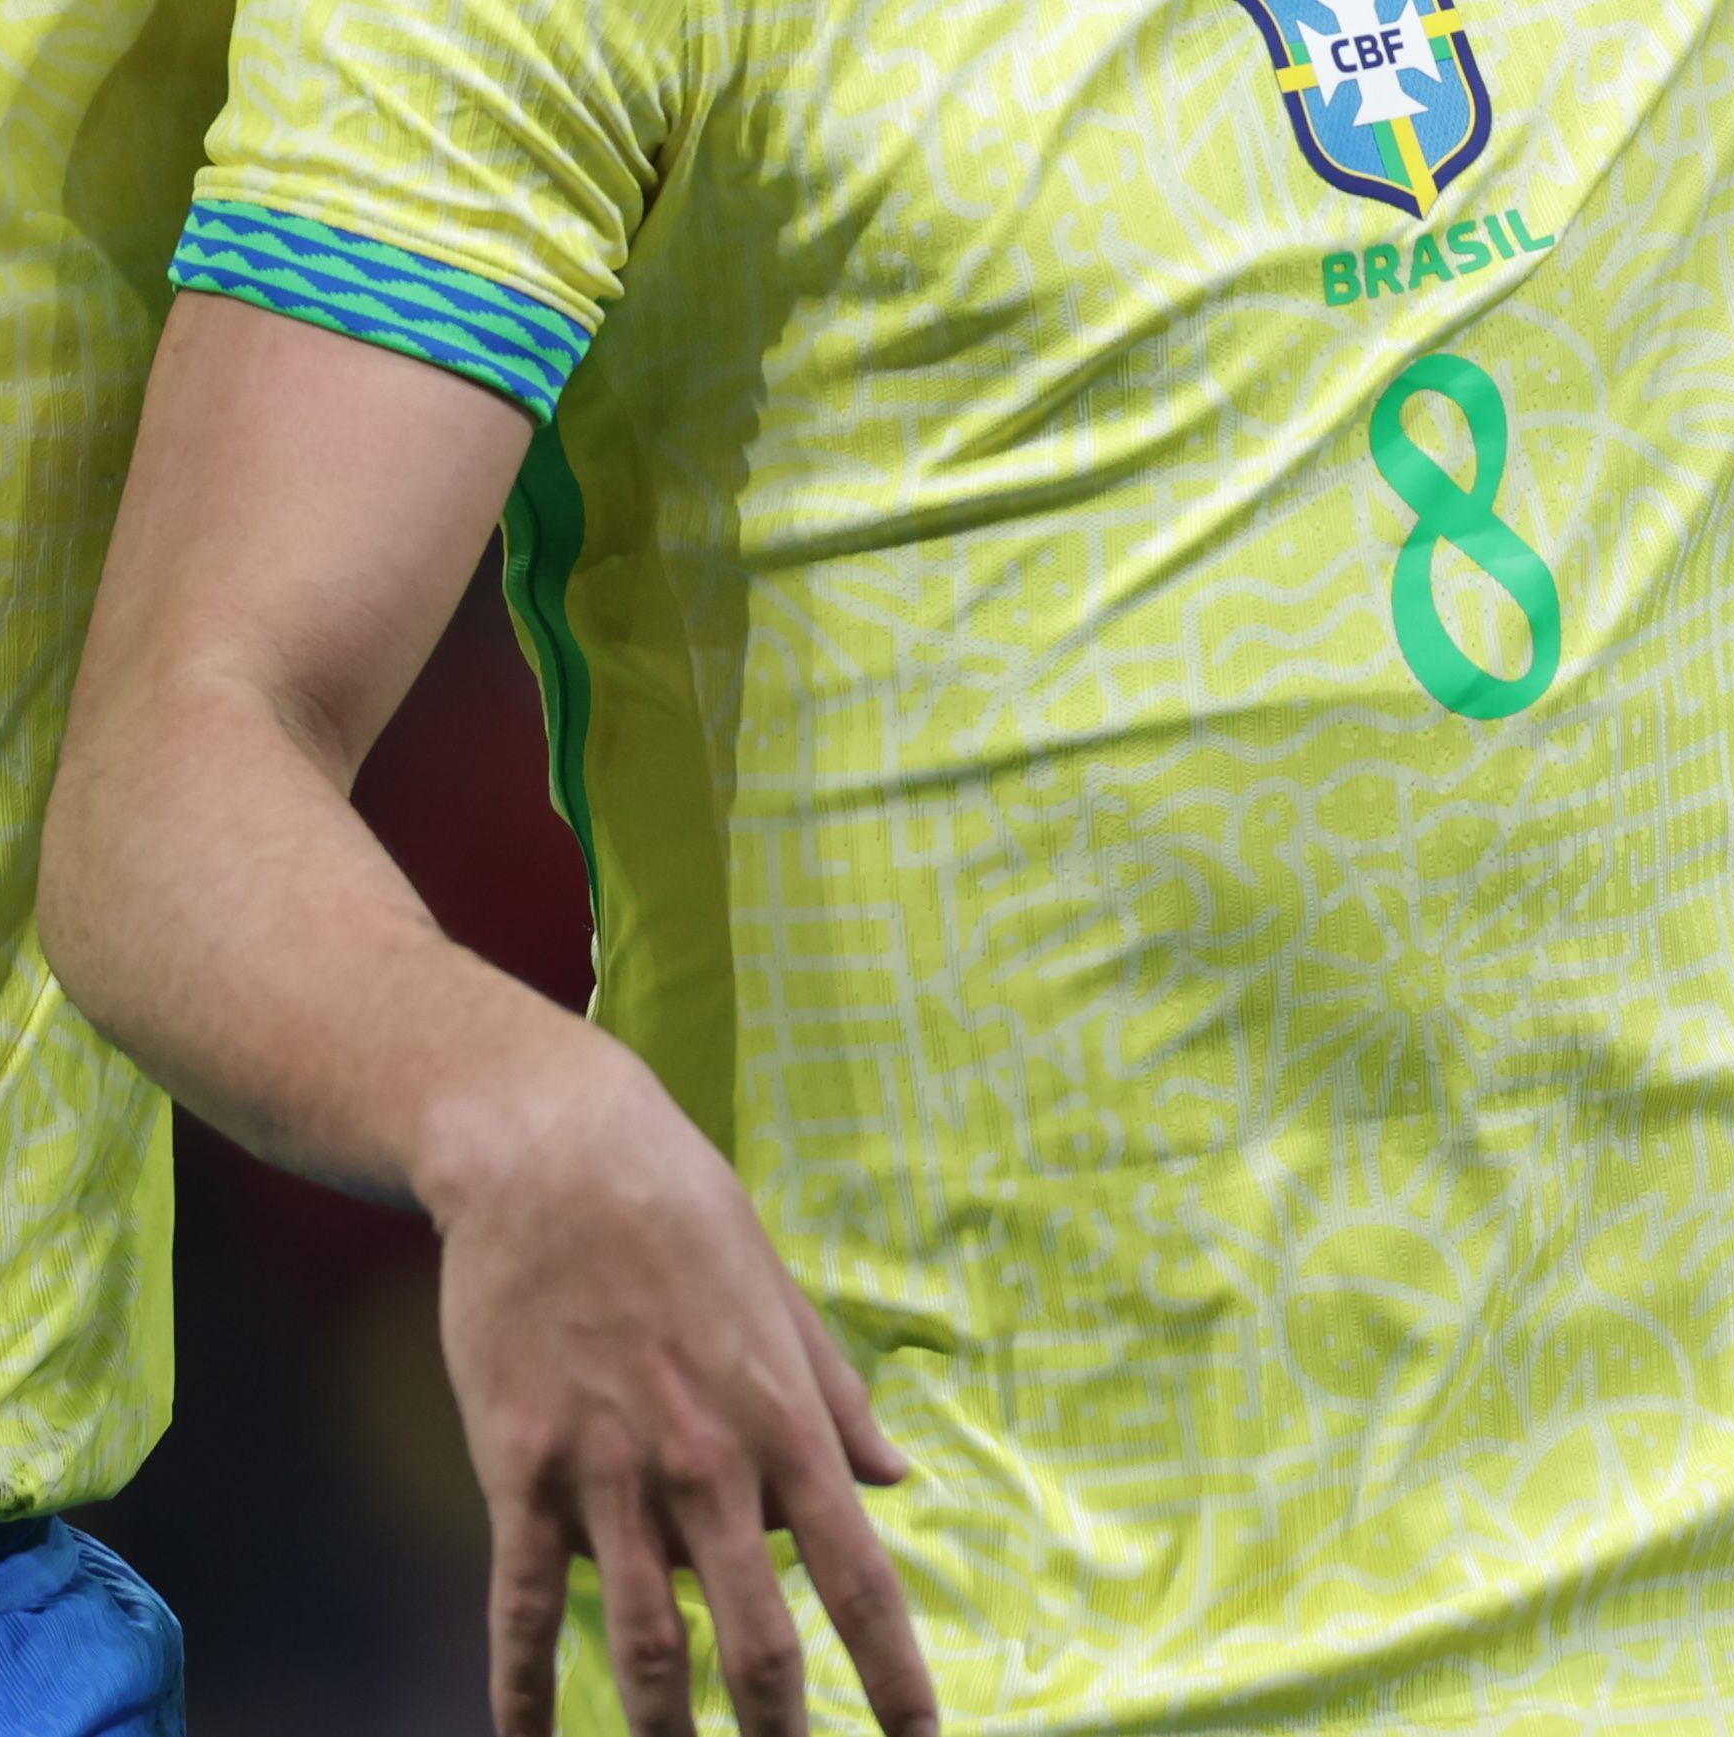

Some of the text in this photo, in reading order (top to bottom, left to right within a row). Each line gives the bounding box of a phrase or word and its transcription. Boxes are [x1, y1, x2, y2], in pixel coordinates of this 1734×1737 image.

[1330, 27, 1405, 73] CBF
[1321, 208, 1556, 308] BRASIL
[1369, 353, 1561, 720] 8
